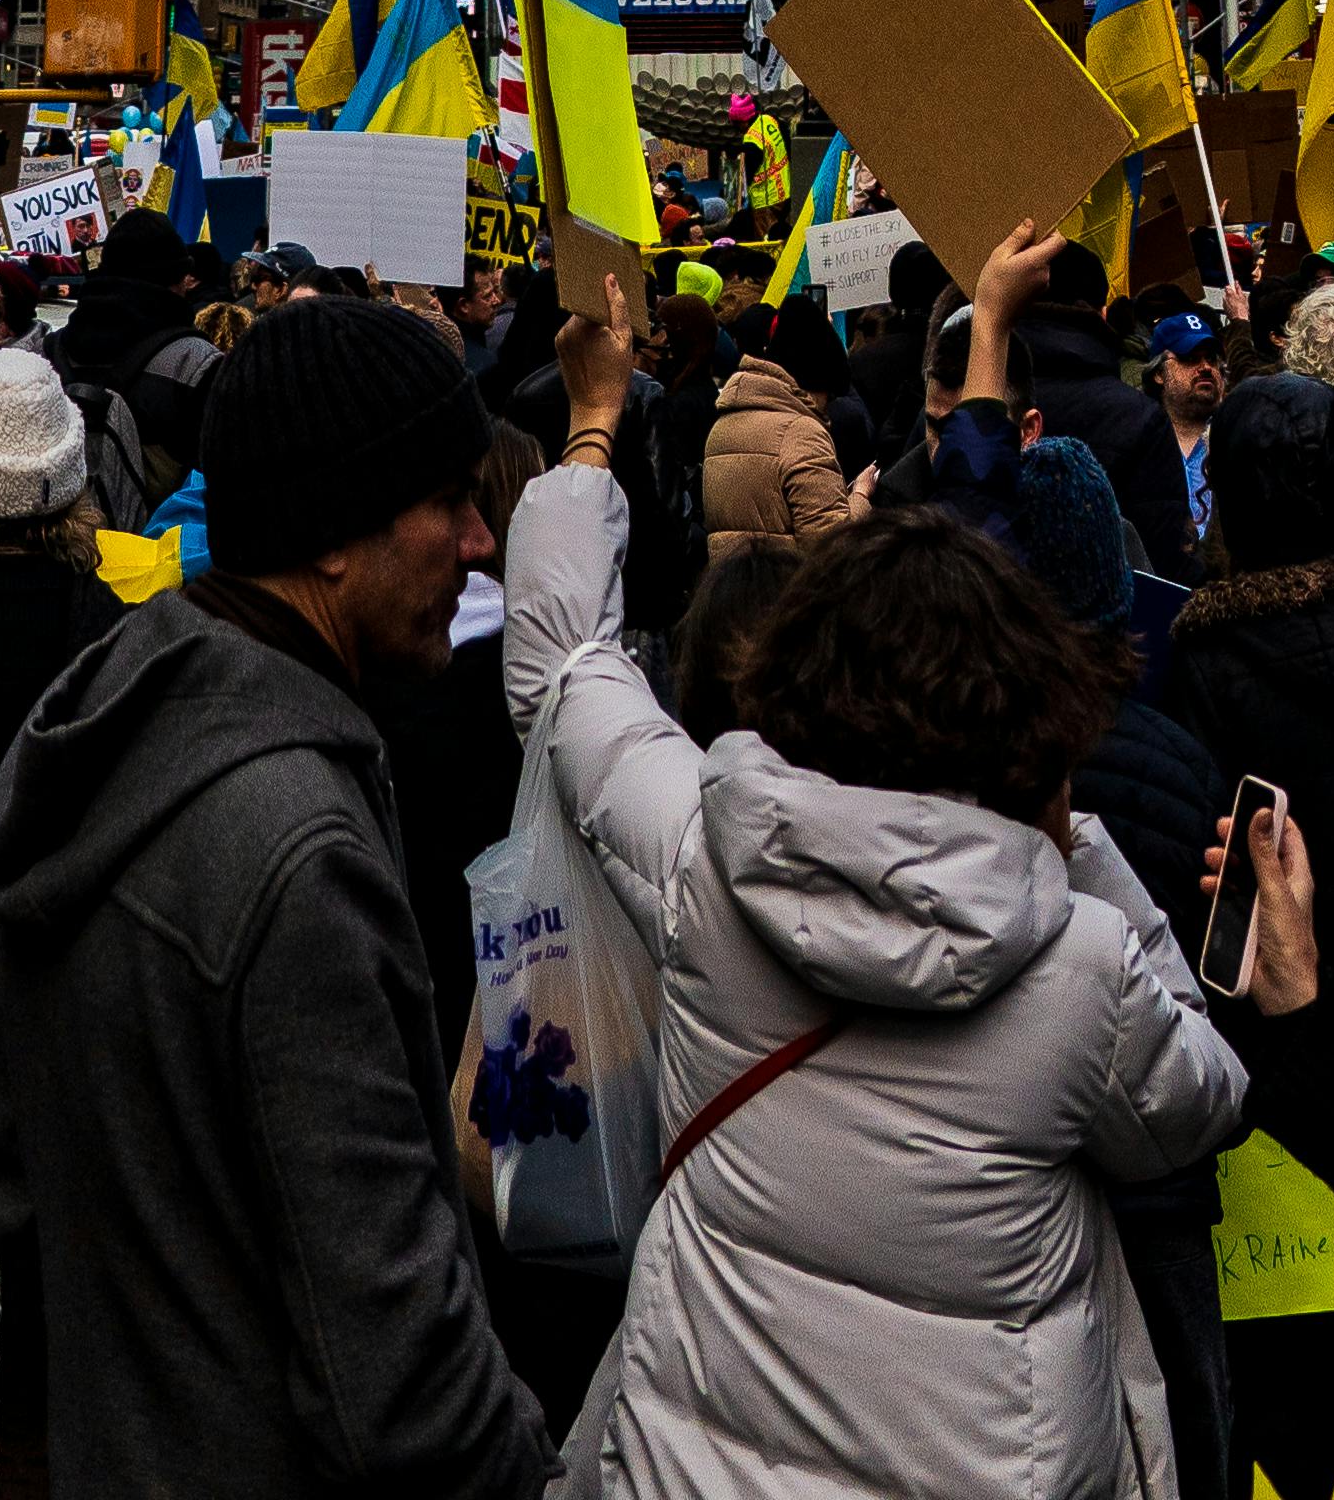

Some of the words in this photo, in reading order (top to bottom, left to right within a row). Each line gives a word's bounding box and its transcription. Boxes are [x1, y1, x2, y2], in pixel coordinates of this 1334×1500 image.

[13, 191, 52, 223] YOU
[52, 178, 100, 217] SUCK
[832, 225, 864, 246] CLOSE
[865, 224, 882, 238] THE
[883, 220, 902, 235] SKY
[834, 250, 848, 268] NO
[850, 247, 871, 266] FLY
[837, 269, 878, 290] SUPPORT
